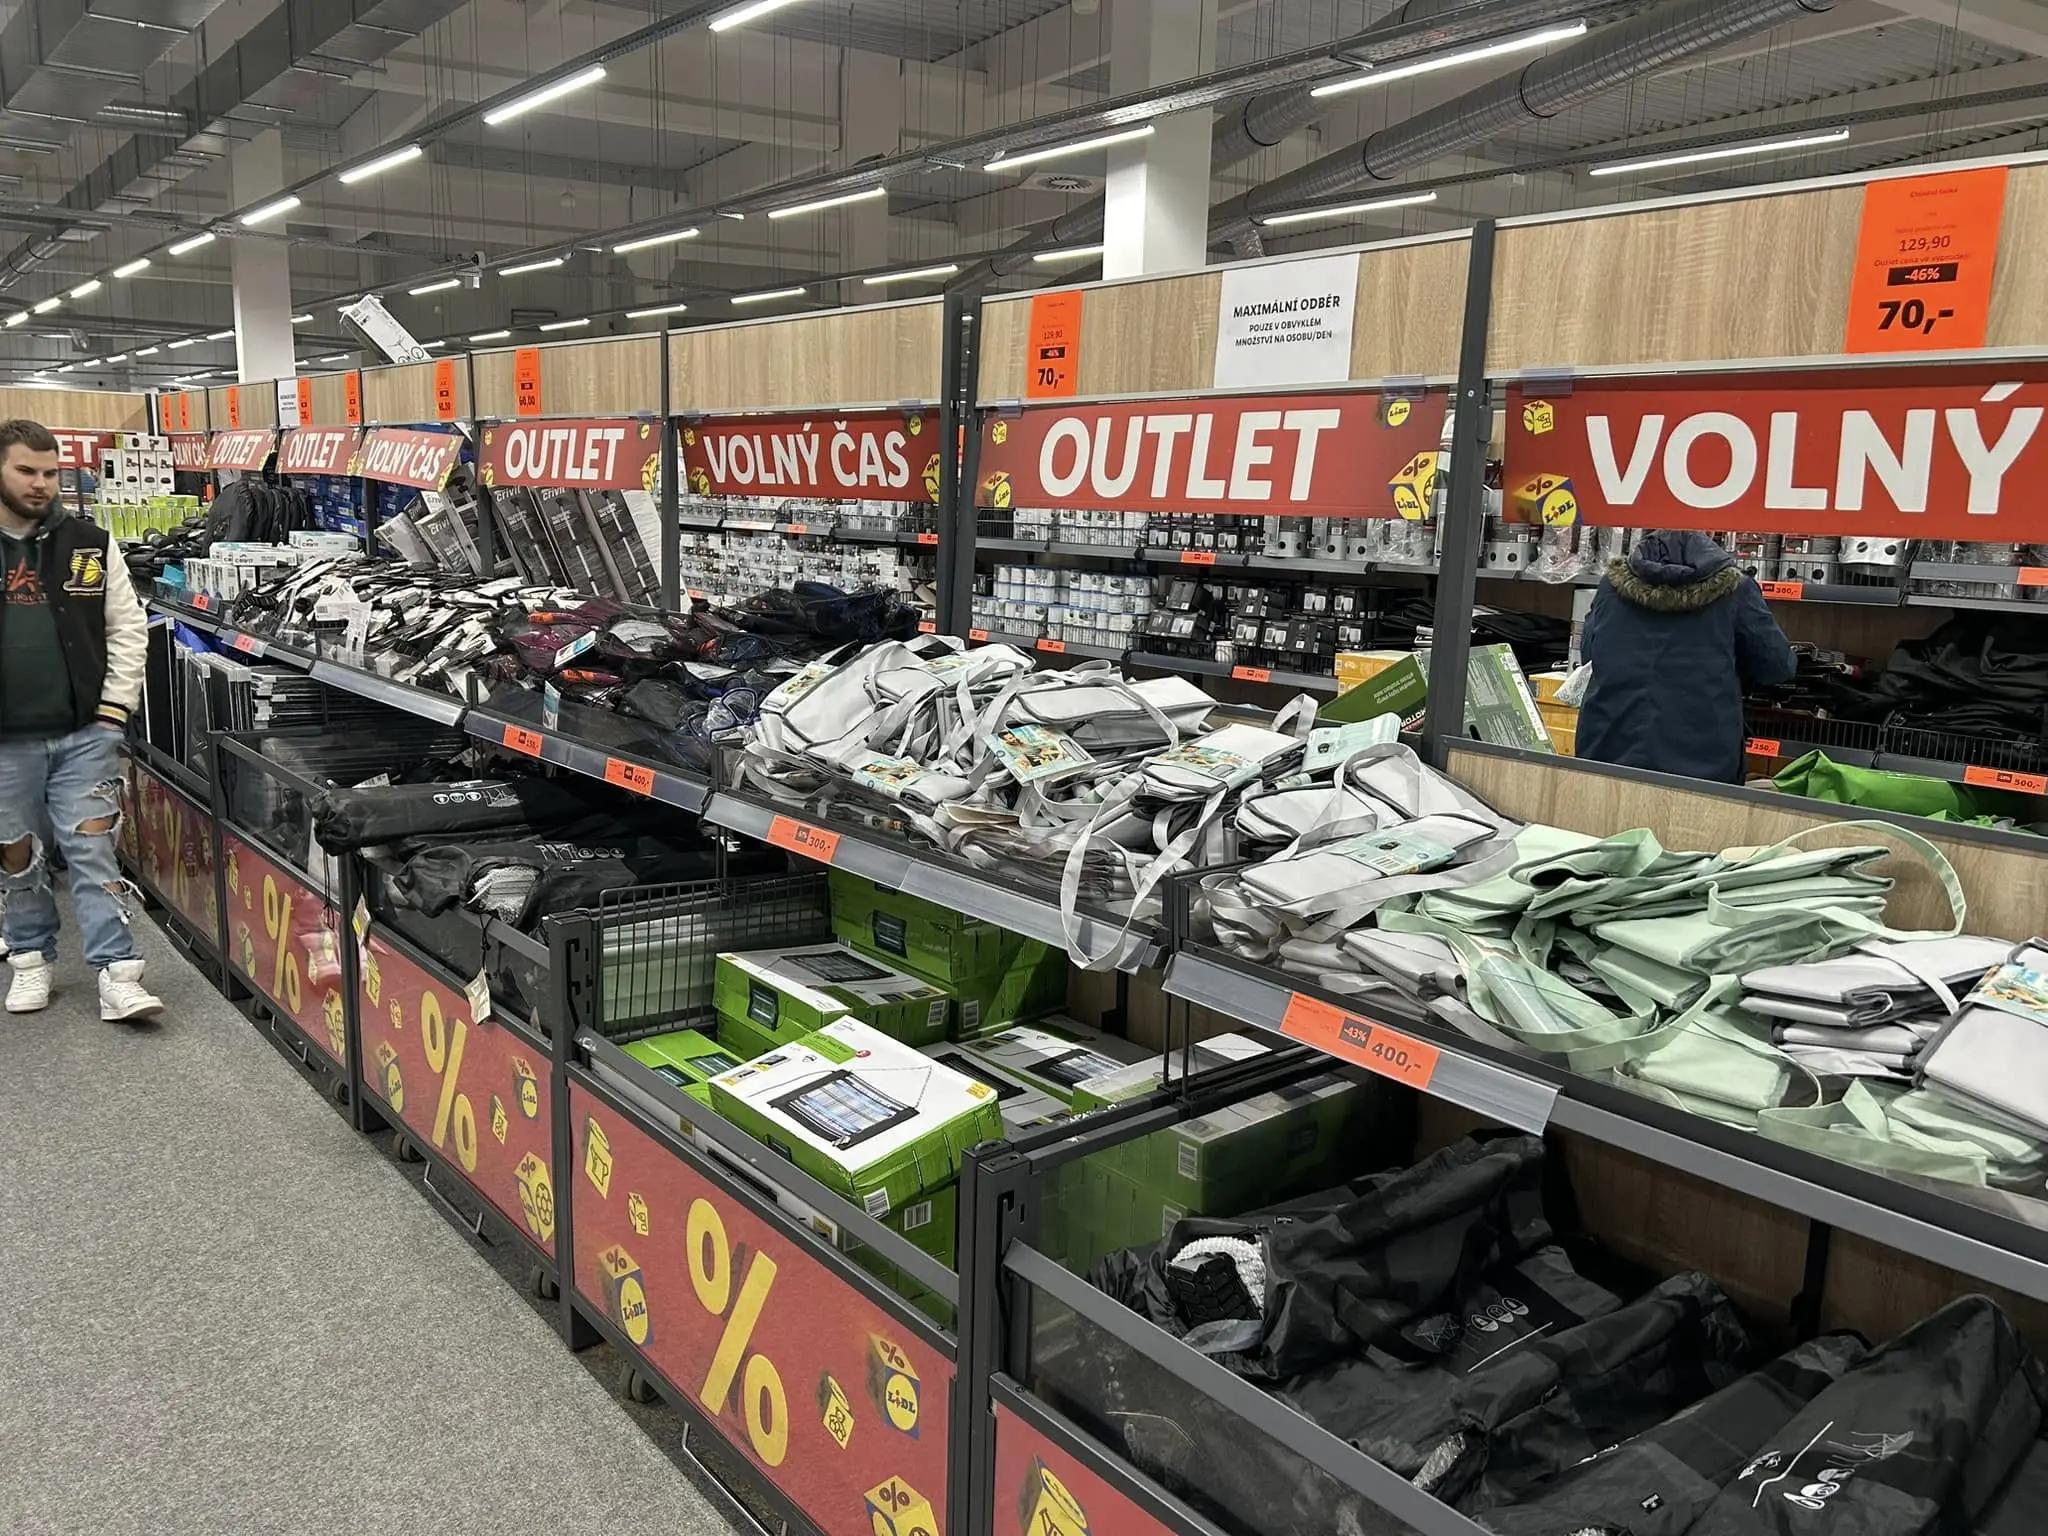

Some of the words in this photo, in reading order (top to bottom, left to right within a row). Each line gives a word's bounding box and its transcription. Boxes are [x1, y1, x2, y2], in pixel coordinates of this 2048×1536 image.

[1900, 235, 1950, 252] 129,90
[1904, 267, 1940, 281] -46%
[1233, 297, 1299, 318] MAXIMÁLNÍ
[1300, 293, 1341, 311] ODBĚR
[1878, 299, 1954, 334] 70,-
[1249, 322, 1273, 333] POUZE
[1274, 322, 1281, 330] V
[1280, 316, 1322, 330] OBVYKLÉM
[1274, 334, 1285, 343] NA
[1286, 330, 1333, 343] OSOBU/DEN
[1037, 367, 1065, 389] 70,-
[56, 435, 99, 463] ET
[213, 435, 264, 465] OUTLET
[287, 432, 345, 469] OUTLET
[365, 436, 415, 475] VOLNÝ
[409, 438, 446, 482] ČAS
[505, 428, 625, 480] OUTLET
[702, 421, 820, 486] VOLNÝ
[830, 420, 910, 488] ČAS
[1039, 409, 1341, 501] OUTLET
[1585, 381, 2045, 515] VOLNÝ
[429, 515, 450, 535] crivi
[808, 836, 831, 853] 300,-
[1344, 1025, 1368, 1043] -43%
[1371, 1042, 1422, 1073] 400,-
[421, 989, 478, 1174] %
[686, 1198, 789, 1467] %
